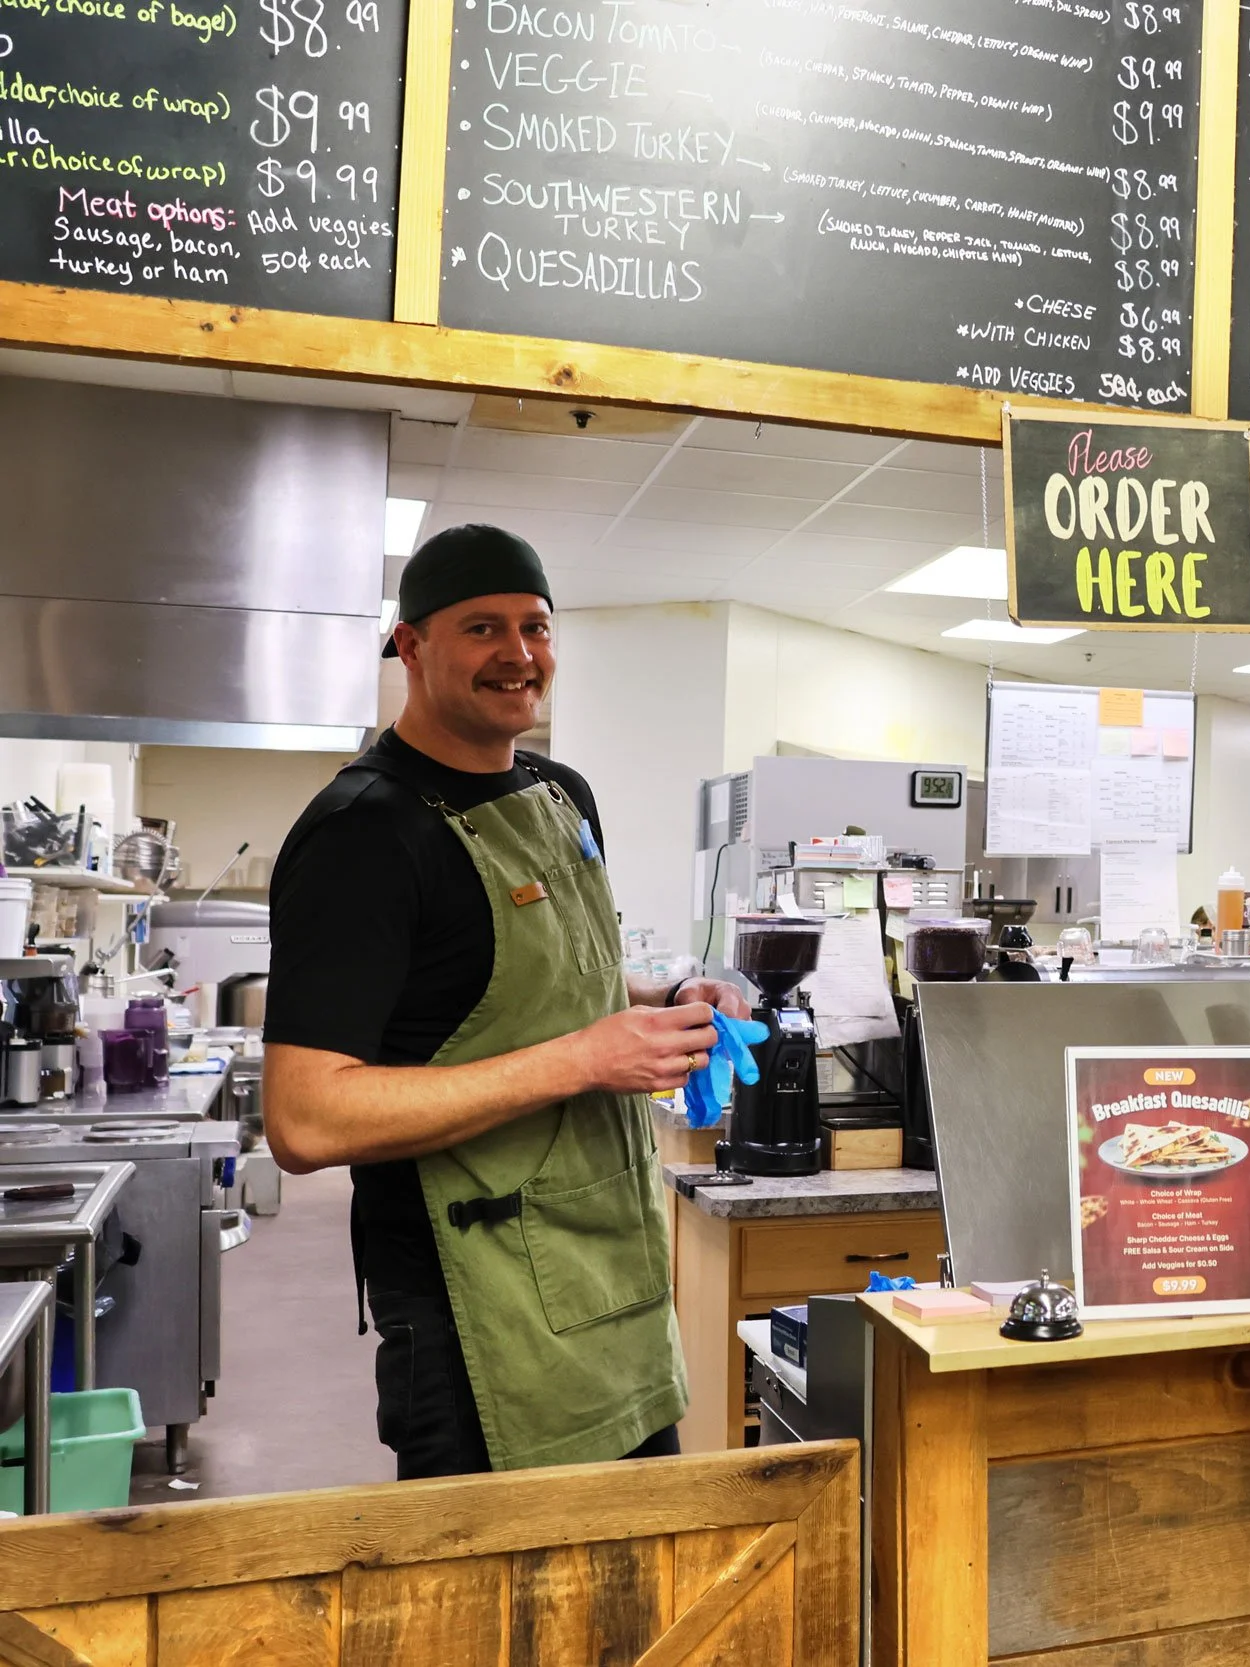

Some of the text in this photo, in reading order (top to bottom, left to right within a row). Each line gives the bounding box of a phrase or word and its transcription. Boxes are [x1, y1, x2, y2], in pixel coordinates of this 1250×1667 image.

[172, 5, 237, 43] bagel)
[488, 0, 717, 52] BACON TOMATO
[1124, 1, 1182, 35] $8.99
[485, 47, 648, 98] VEGGIE
[1117, 55, 1183, 91] $9.99
[164, 92, 232, 124] wrap)
[250, 85, 371, 154] $9.99
[483, 103, 736, 166] SMOKED TURKEY
[146, 162, 227, 188] wrap)
[256, 157, 378, 203] $9.99
[58, 186, 237, 231] Meat options:
[483, 173, 742, 225] SOUTHWESTERN
[54, 217, 241, 260] Sausage, bacon,
[248, 209, 298, 236] Add
[554, 213, 690, 250] TURKEY
[49, 248, 228, 285] turkey or ham
[318, 249, 371, 270] each
[477, 232, 702, 302] QUESADILLAS
[1115, 260, 1180, 292] $8.99
[1120, 302, 1182, 334] $6.99
[1024, 327, 1091, 351] CHICKEN
[1009, 366, 1076, 395] VEGGIES
[1147, 380, 1188, 405] each
[1068, 428, 1153, 477] Please
[1044, 472, 1216, 546] ORDER
[1076, 546, 1211, 619] HERE
[1155, 1071, 1184, 1082] NEW
[1091, 1091, 1250, 1122] Breakfast Quesadilla
[1150, 1189, 1202, 1198] Choice of Wrap
[1212, 1233, 1229, 1242] Eggs
[1142, 1259, 1218, 1271] Add Veggies for $0.50
[1162, 1279, 1198, 1292] $9.99
